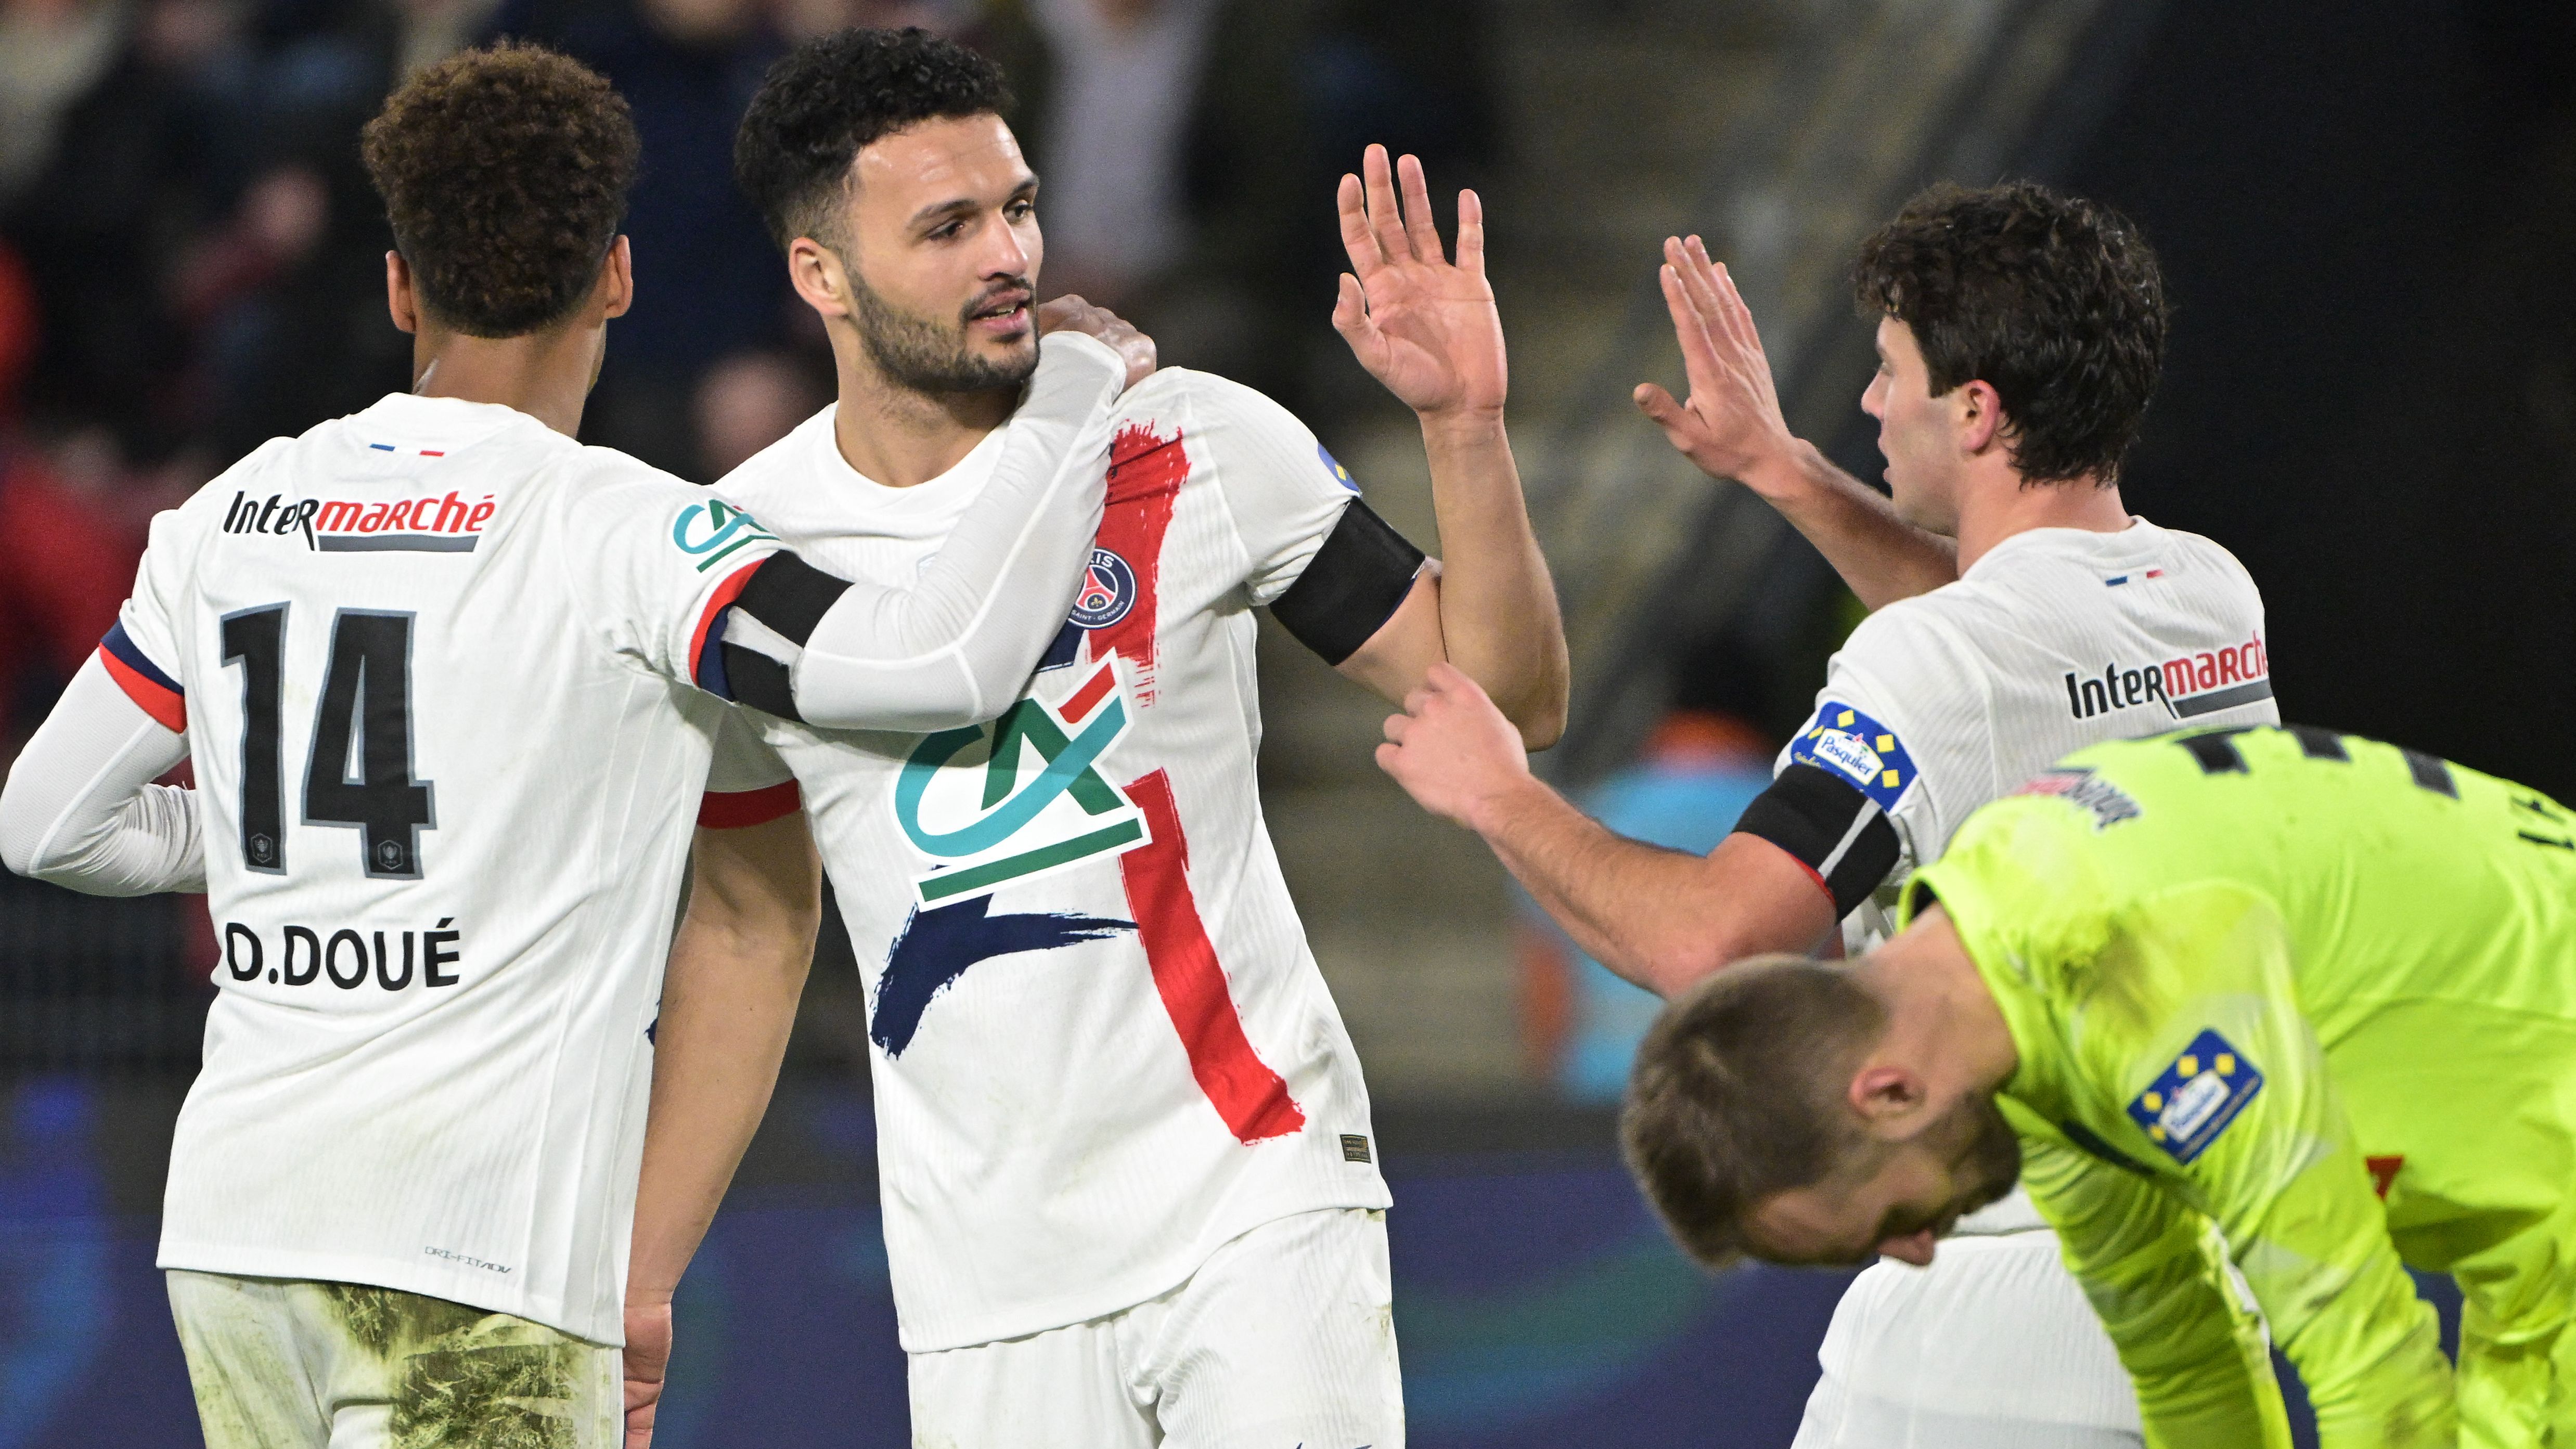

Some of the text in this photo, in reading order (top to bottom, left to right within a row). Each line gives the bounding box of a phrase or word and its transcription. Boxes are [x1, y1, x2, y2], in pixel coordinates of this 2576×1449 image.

[2065, 630, 2269, 719] Intermarch
[220, 601, 437, 881] 14
[1821, 735, 1874, 775] Pasquier
[226, 917, 460, 991] D.DOUÉ
